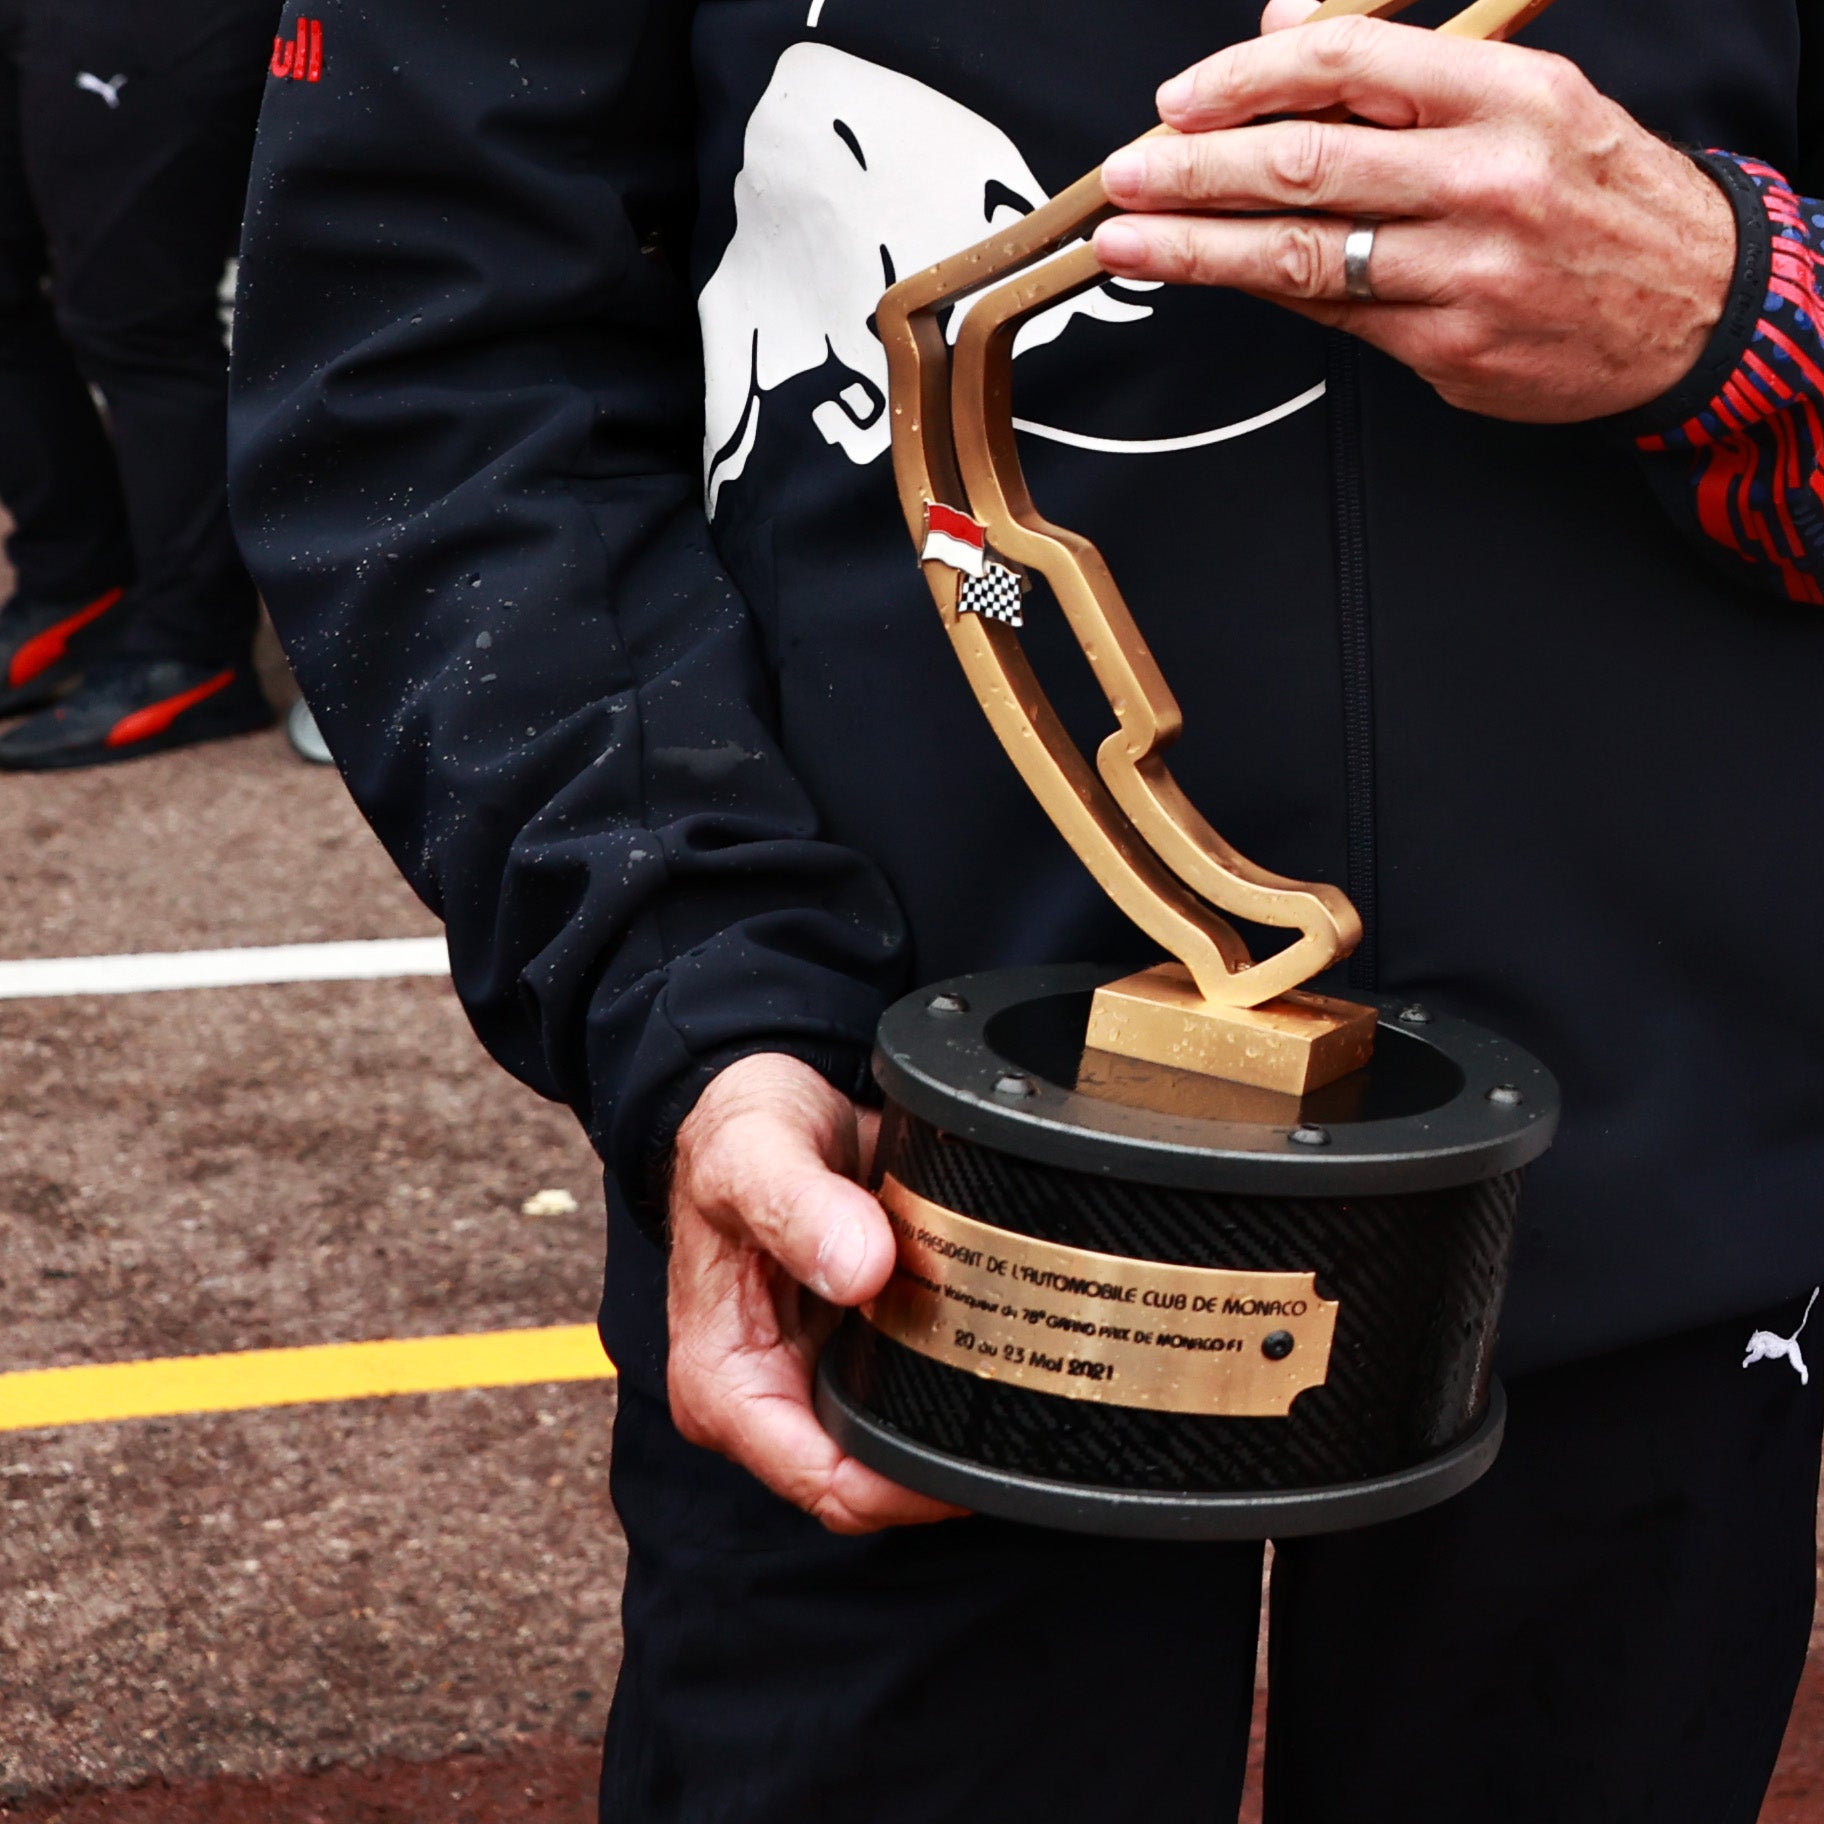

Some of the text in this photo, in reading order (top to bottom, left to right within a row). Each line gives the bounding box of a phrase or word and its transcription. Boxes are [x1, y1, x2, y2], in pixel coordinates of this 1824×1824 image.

[986, 1256, 1009, 1277] DE
[1142, 1290, 1188, 1311] CLUB
[1191, 1295, 1217, 1314] DE
[1221, 1299, 1308, 1317] MONACO
[954, 1327, 976, 1351] 20
[1002, 1344, 1025, 1364] 23
[1066, 1357, 1116, 1381] 2021
[1133, 1329, 1154, 1346] DE
[1155, 1332, 1225, 1352] MONACO
